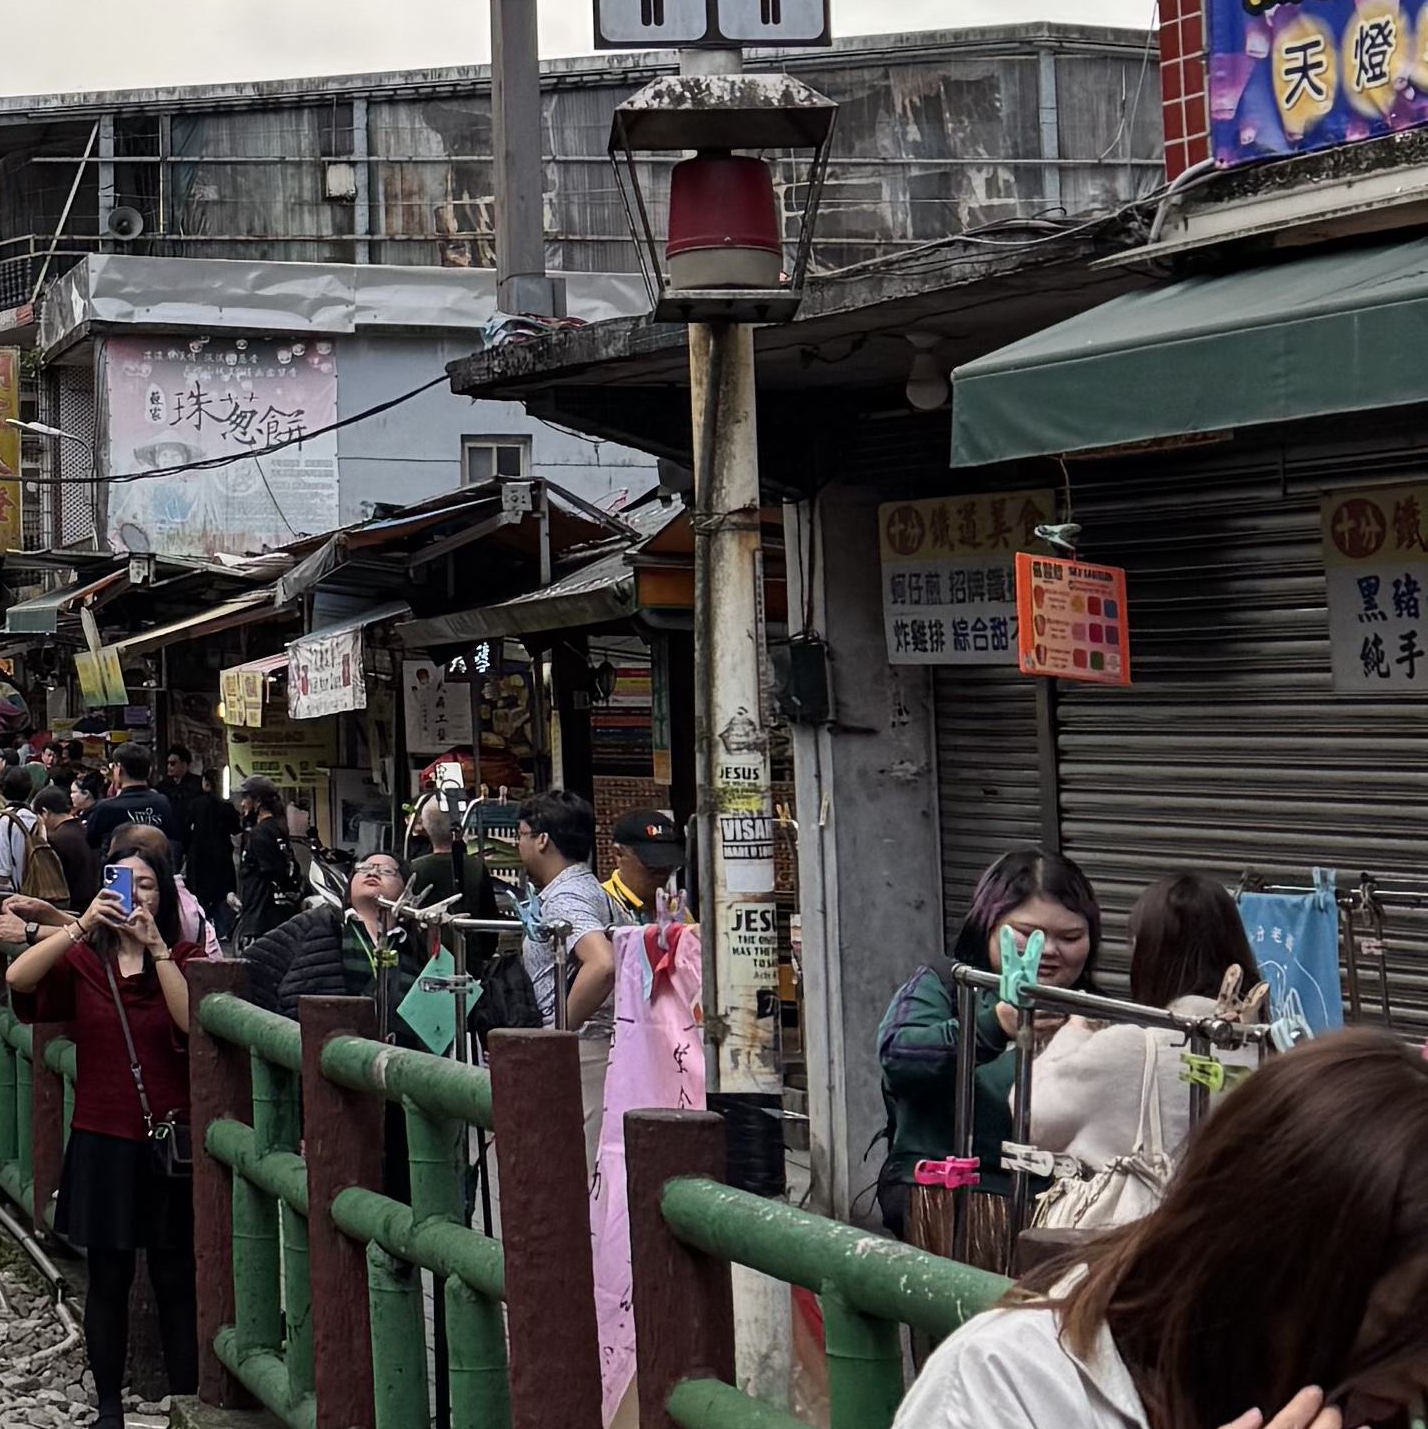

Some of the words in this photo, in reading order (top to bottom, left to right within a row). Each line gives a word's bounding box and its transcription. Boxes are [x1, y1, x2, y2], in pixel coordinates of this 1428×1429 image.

[894, 619, 945, 653] 炸雞排
[719, 766, 760, 781] JESUS
